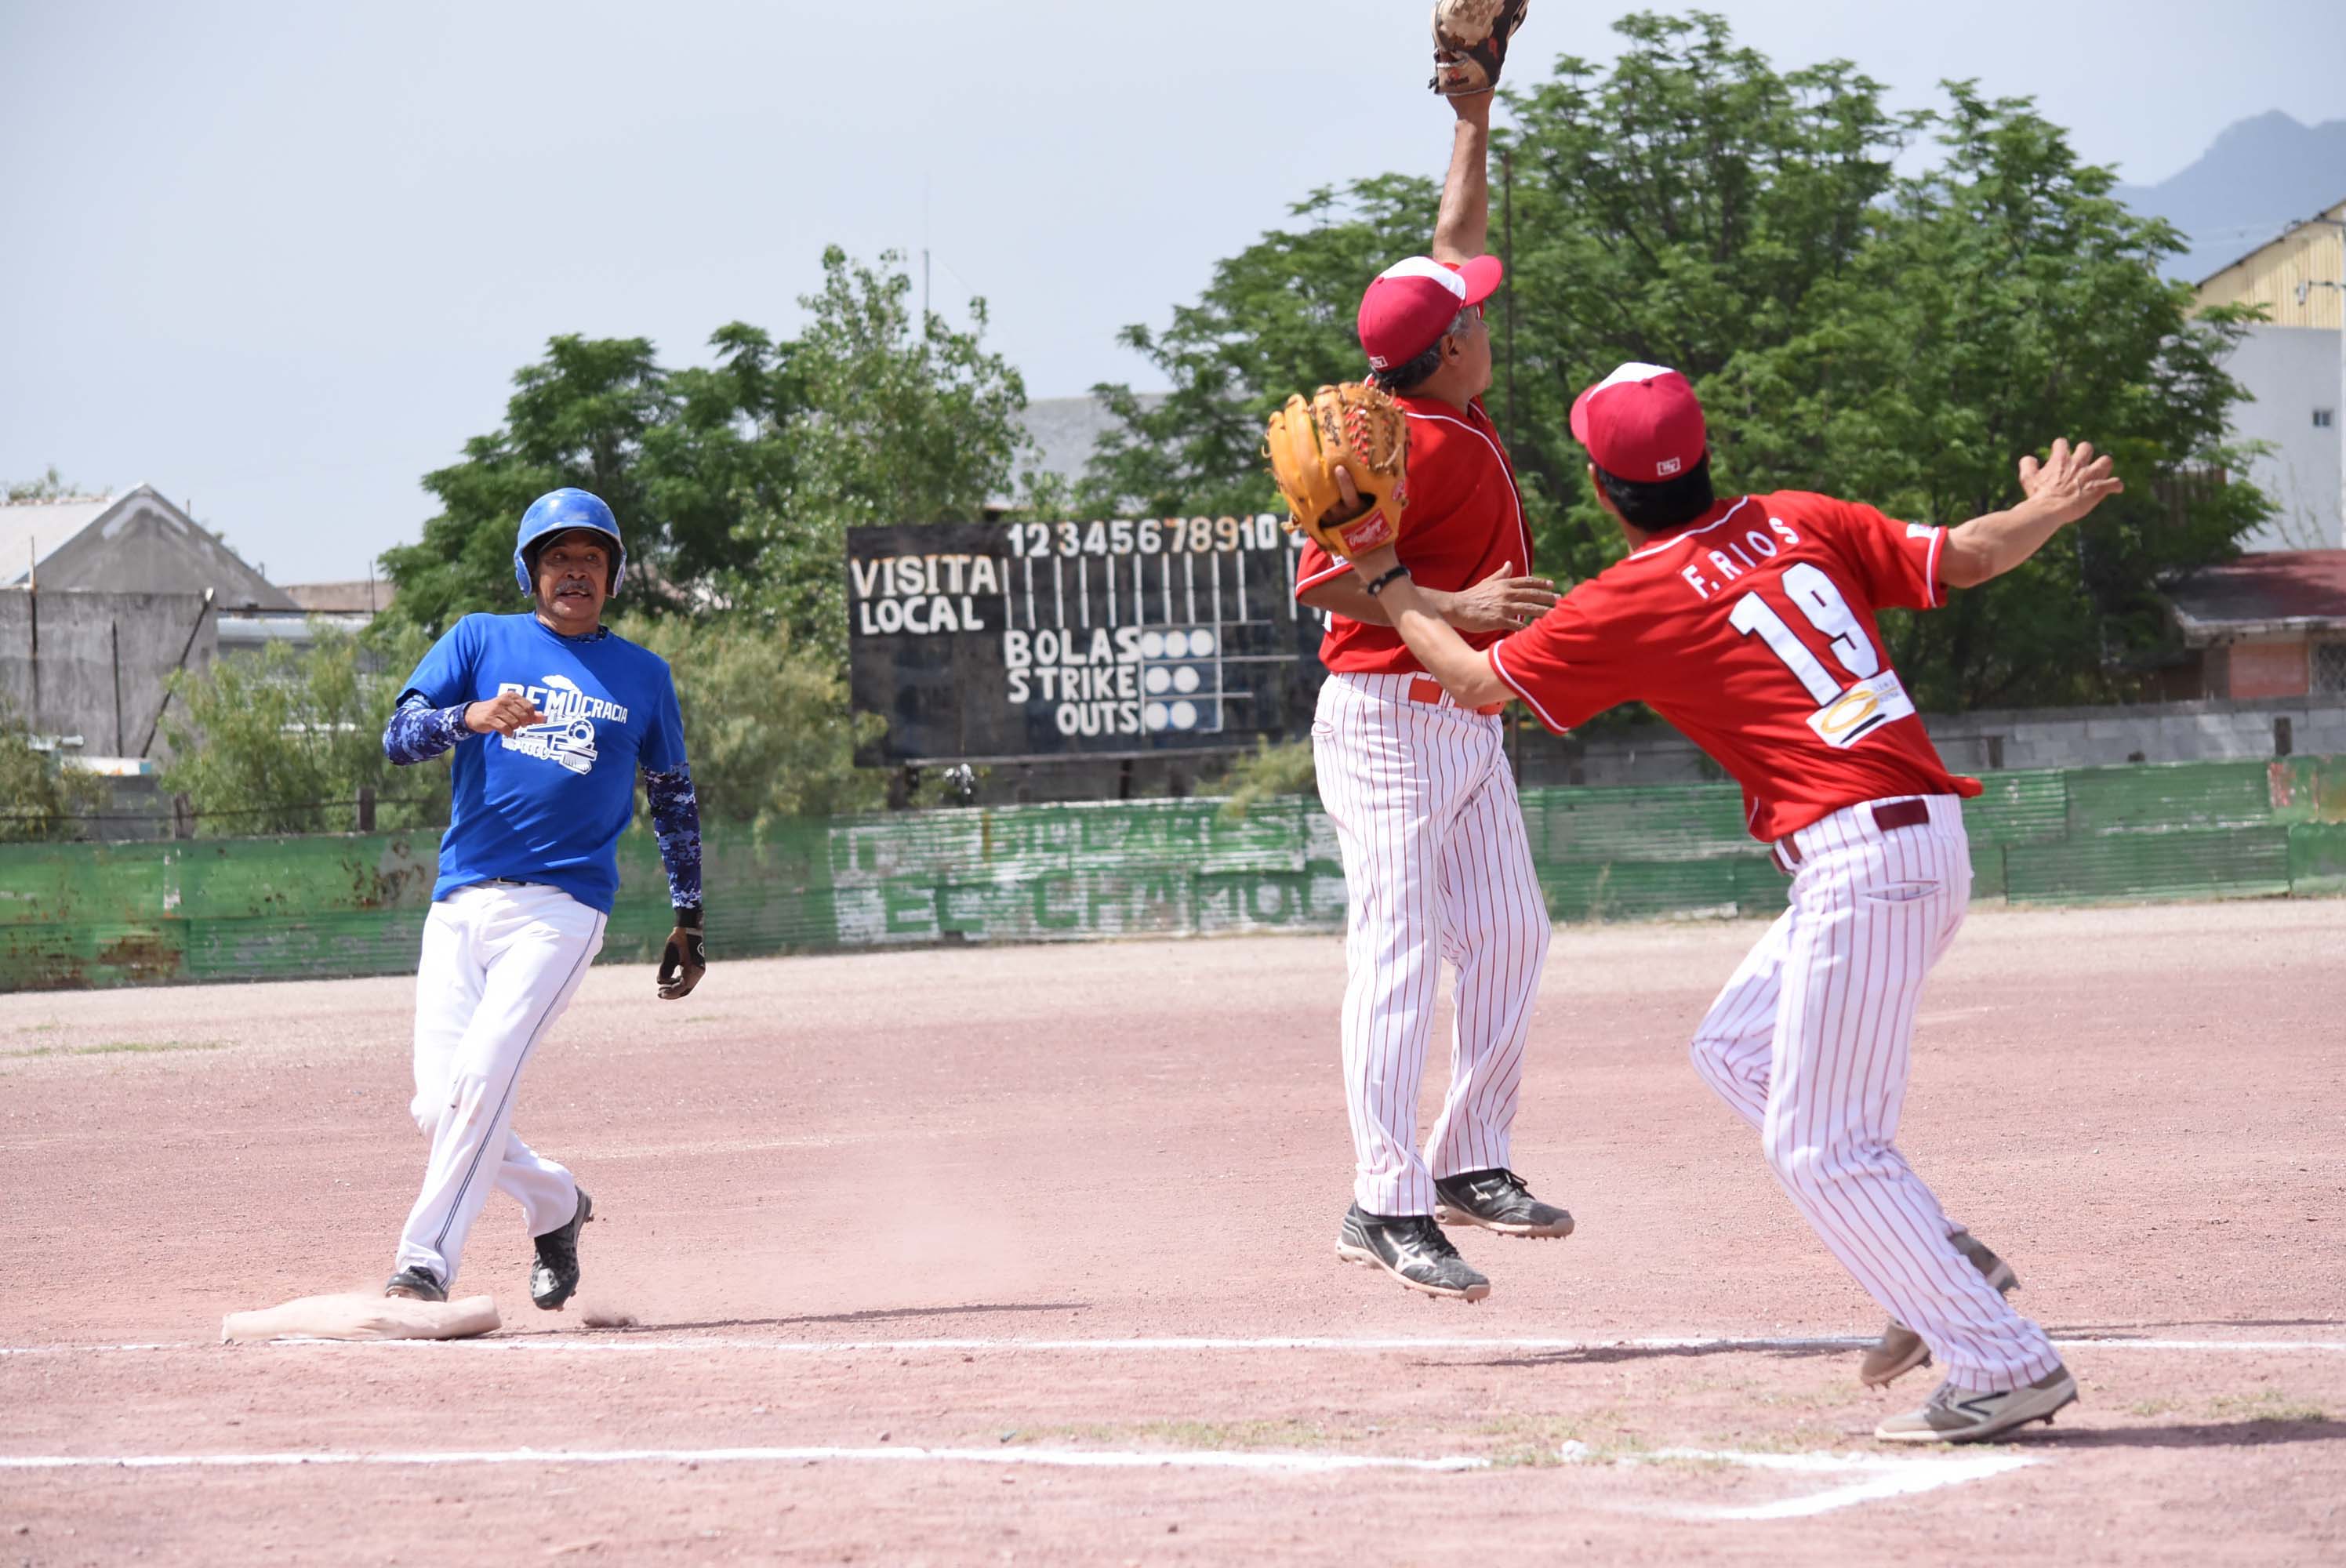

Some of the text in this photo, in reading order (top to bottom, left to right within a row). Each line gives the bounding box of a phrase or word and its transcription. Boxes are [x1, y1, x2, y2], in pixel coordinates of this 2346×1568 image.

[850, 554, 999, 598] VISITA
[860, 594, 985, 636] LOCAL
[1727, 561, 1880, 707] 19
[1004, 627, 1143, 670] BOLAS
[1008, 663, 1138, 704] STRIKE
[1055, 700, 1140, 737] OUTS
